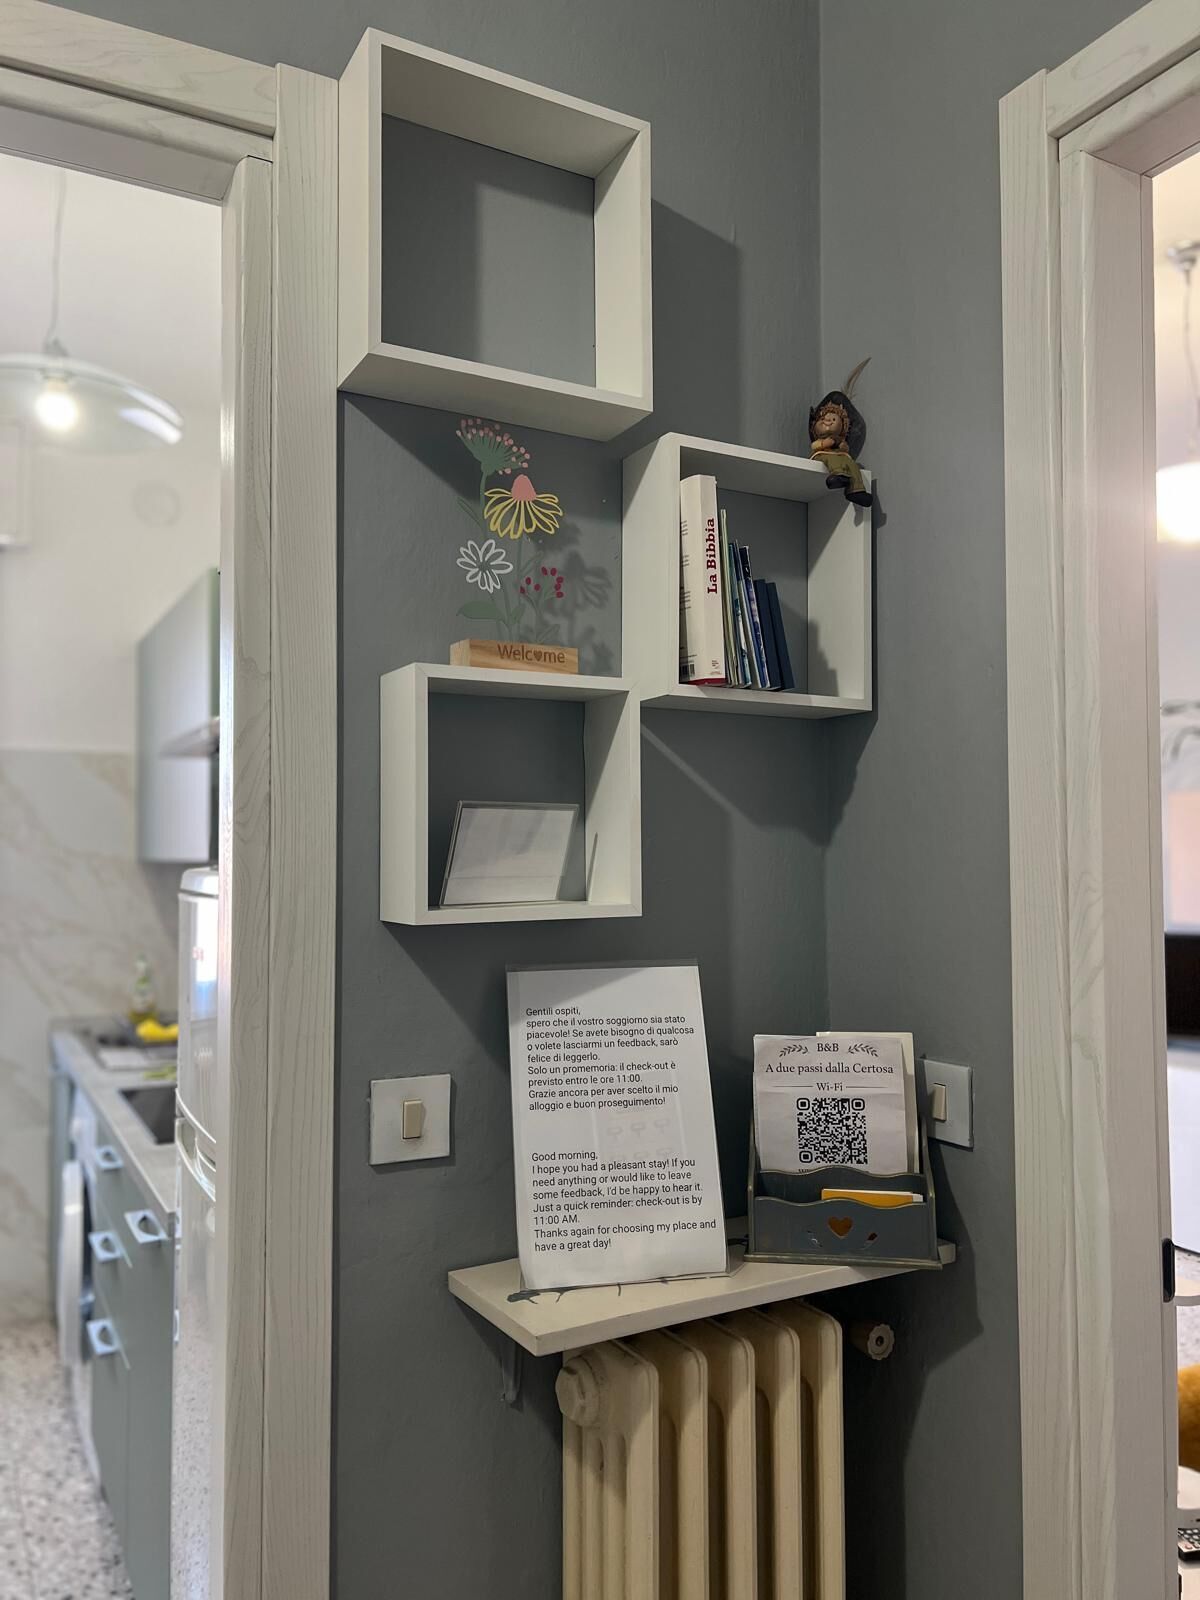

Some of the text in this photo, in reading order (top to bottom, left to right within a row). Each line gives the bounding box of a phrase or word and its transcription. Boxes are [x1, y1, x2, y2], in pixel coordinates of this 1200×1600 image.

[706, 518, 718, 594] La Bibbia
[526, 1007, 581, 1016] Gentili ospiti,
[526, 1020, 551, 1028] spero
[552, 1018, 568, 1026] che
[577, 1017, 604, 1025] vostro
[606, 1016, 648, 1026] soggiorno
[650, 1016, 663, 1024] sia
[526, 1026, 694, 1040] piacevole! Se avete bisogno di qualcosa
[534, 1042, 561, 1050] volete
[563, 1040, 602, 1049] lasciarmi
[617, 1038, 658, 1048] feedback,
[660, 1038, 678, 1046] sarò
[817, 1043, 839, 1052] B&B
[528, 1054, 551, 1063] felice
[563, 1052, 600, 1063] leggerlo.
[528, 1066, 547, 1075] Solo
[563, 1064, 617, 1075] promemoria:
[626, 1062, 668, 1071] check-out
[670, 1061, 676, 1070] è
[765, 1063, 894, 1075] A due passi dalla Certosa
[528, 1077, 563, 1089] previsto
[565, 1077, 588, 1085] entro
[591, 1076, 598, 1084] le
[617, 1074, 642, 1083] 11:00.
[816, 1082, 843, 1091] Wi-Fi
[528, 1089, 556, 1099] Grazie
[558, 1089, 589, 1097] ancora
[591, 1088, 604, 1098] per
[627, 1086, 653, 1094] scelto
[529, 1101, 564, 1112] alloggio
[574, 1100, 596, 1108] buon
[598, 1097, 666, 1109] proseguimento!
[532, 1151, 598, 1162] Good morning,
[537, 1165, 560, 1175] hope
[562, 1165, 579, 1175] you
[581, 1162, 598, 1172] had
[608, 1161, 646, 1171] pleasant
[648, 1159, 670, 1170] stay!
[680, 1159, 696, 1168] you
[533, 1178, 555, 1187] need
[558, 1176, 597, 1186] anything
[610, 1174, 638, 1183] would
[640, 1172, 655, 1181] like
[668, 1171, 691, 1179] leave
[533, 1191, 558, 1199] some
[561, 1188, 605, 1198] feedback,
[607, 1187, 617, 1196] I'd
[619, 1186, 630, 1195] be
[632, 1185, 659, 1196] happy
[672, 1184, 693, 1192] hear
[533, 1204, 554, 1213] Just
[564, 1201, 588, 1212] quick
[591, 1199, 634, 1209] reminder:
[635, 1197, 680, 1207] check-out
[692, 1195, 702, 1205] by
[534, 1214, 580, 1225] 11:00 AM.
[534, 1229, 568, 1238] Thanks
[570, 1227, 595, 1237] again
[612, 1224, 654, 1235] choosing
[656, 1223, 670, 1232] my
[672, 1221, 697, 1232] place
[700, 1219, 716, 1228] and
[535, 1242, 556, 1251] have
[567, 1241, 591, 1251] great
[593, 1239, 611, 1249] day!
